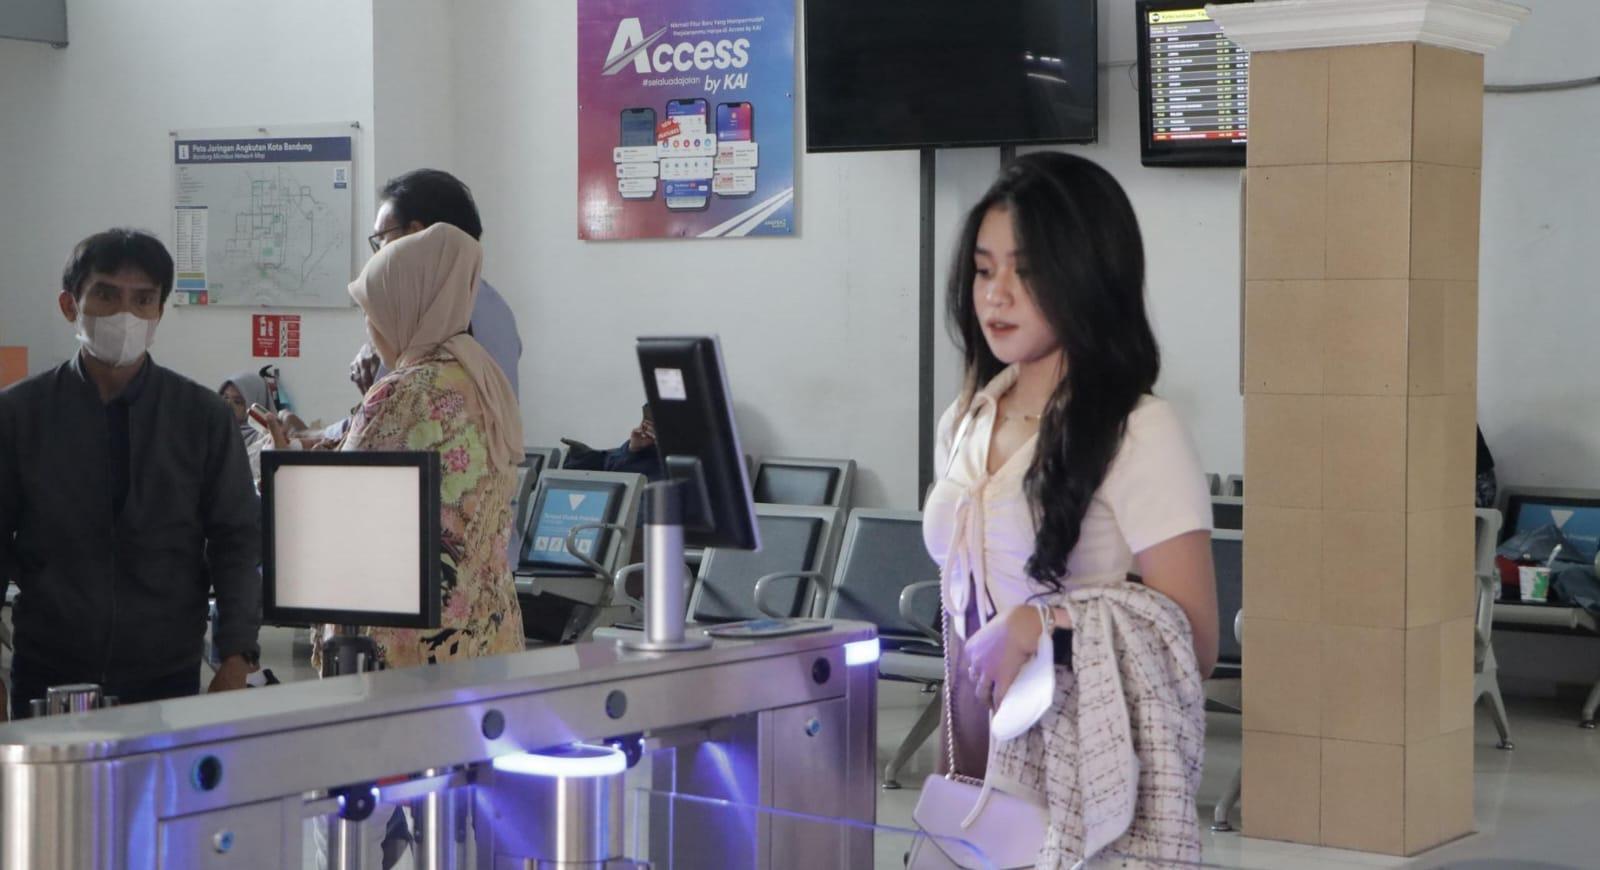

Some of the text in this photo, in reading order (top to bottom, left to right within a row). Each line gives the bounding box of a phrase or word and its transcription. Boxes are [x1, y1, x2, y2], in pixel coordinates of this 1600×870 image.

[602, 17, 750, 75] Access
[642, 76, 700, 87] #selaluadajalan
[704, 73, 748, 94] by KAI
[192, 141, 312, 154] Peta Jaringan Angkutan Kota Bandung
